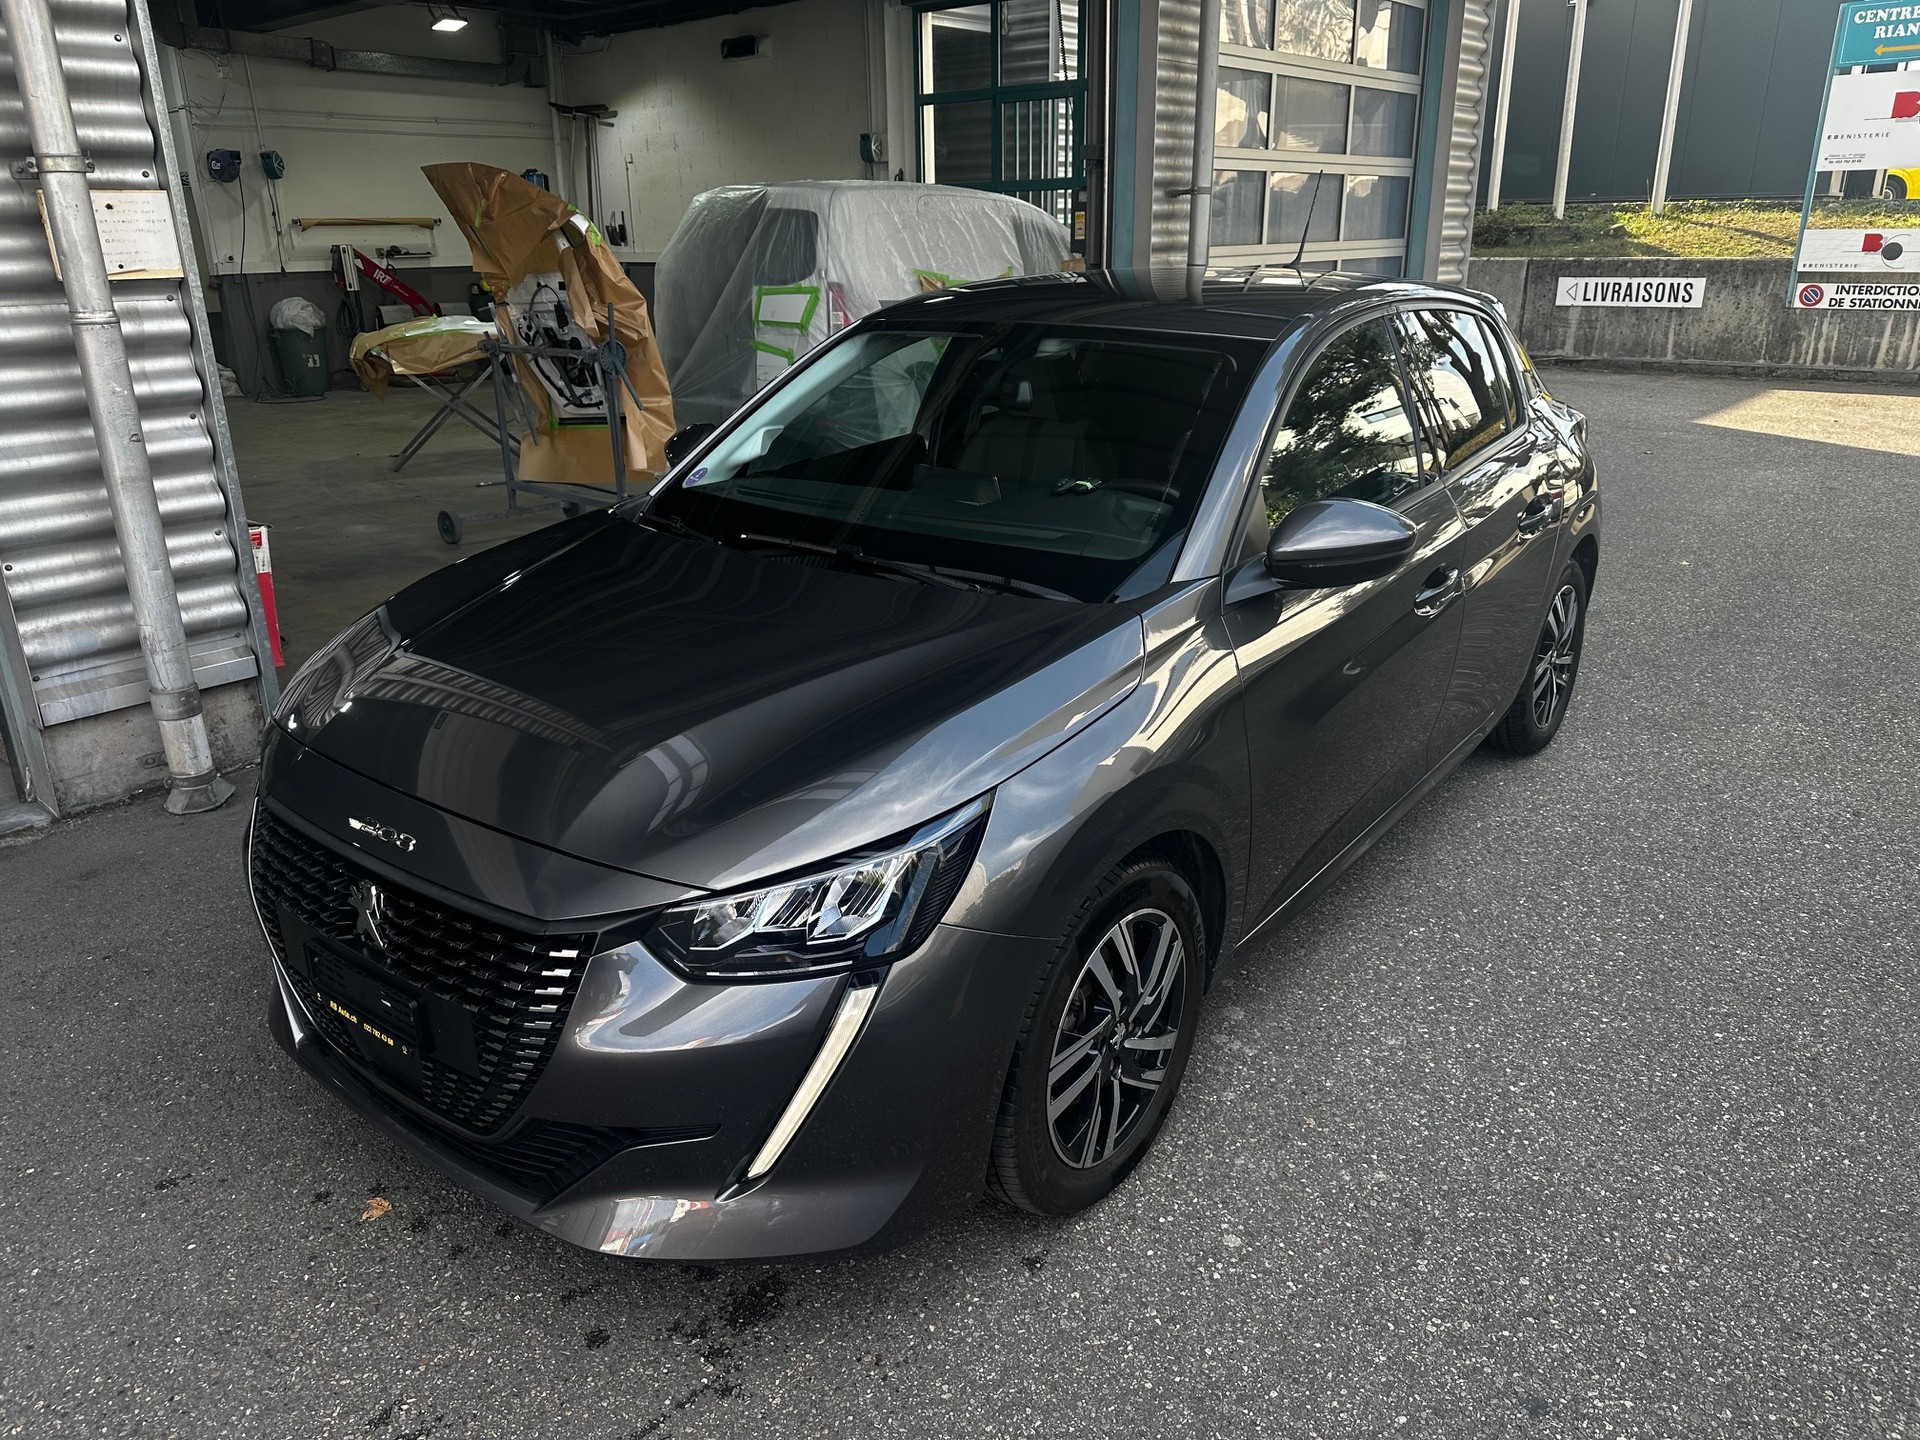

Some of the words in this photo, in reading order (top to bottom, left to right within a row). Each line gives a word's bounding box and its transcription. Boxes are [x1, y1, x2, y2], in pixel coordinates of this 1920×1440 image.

[1854, 6, 1920, 24] CENTRE
[1827, 131, 1891, 140] EBENISTERIE
[373, 268, 392, 284] IRT
[1582, 282, 1694, 303] LIVRAISONS
[1835, 284, 1920, 296] INTERDICTIO
[1828, 298, 1845, 308] DE
[1848, 298, 1920, 309] STATIONN
